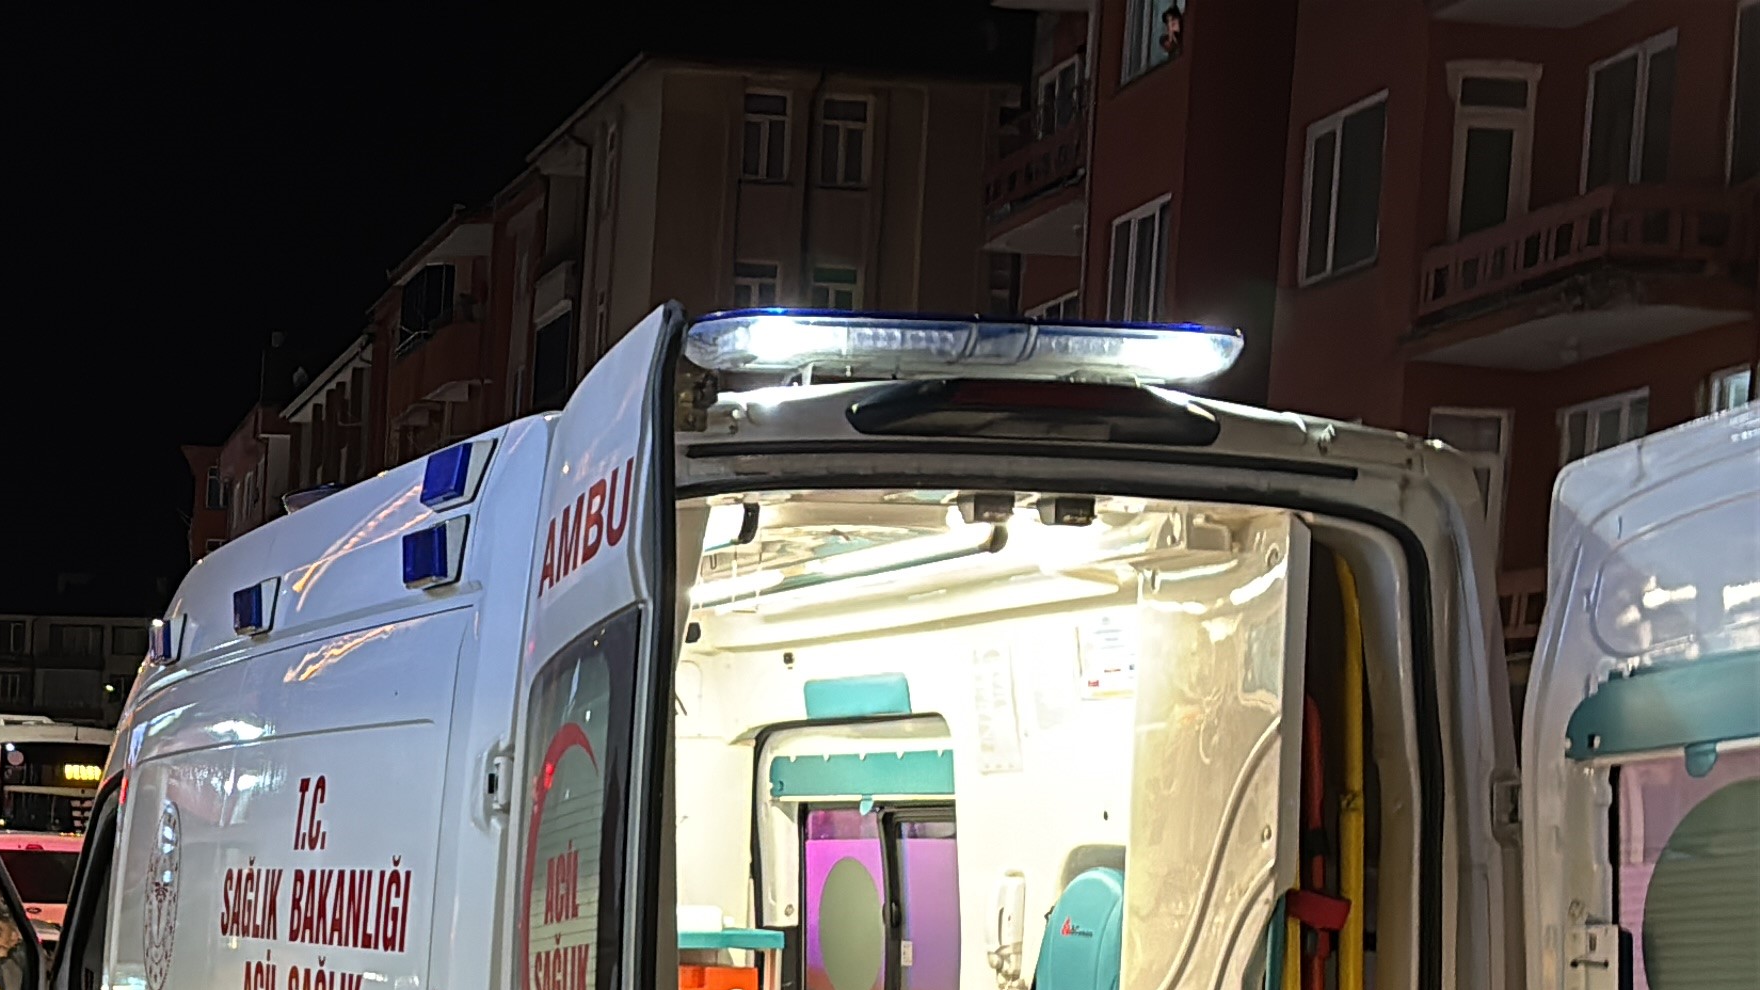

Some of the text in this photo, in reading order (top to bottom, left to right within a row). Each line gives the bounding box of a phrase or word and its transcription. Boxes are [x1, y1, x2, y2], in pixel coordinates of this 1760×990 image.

[537, 456, 634, 599] AMBU
[294, 775, 326, 850] T.C.
[221, 855, 411, 953] SAĞLIK BAKANLIĞI
[544, 840, 581, 926] ACİL
